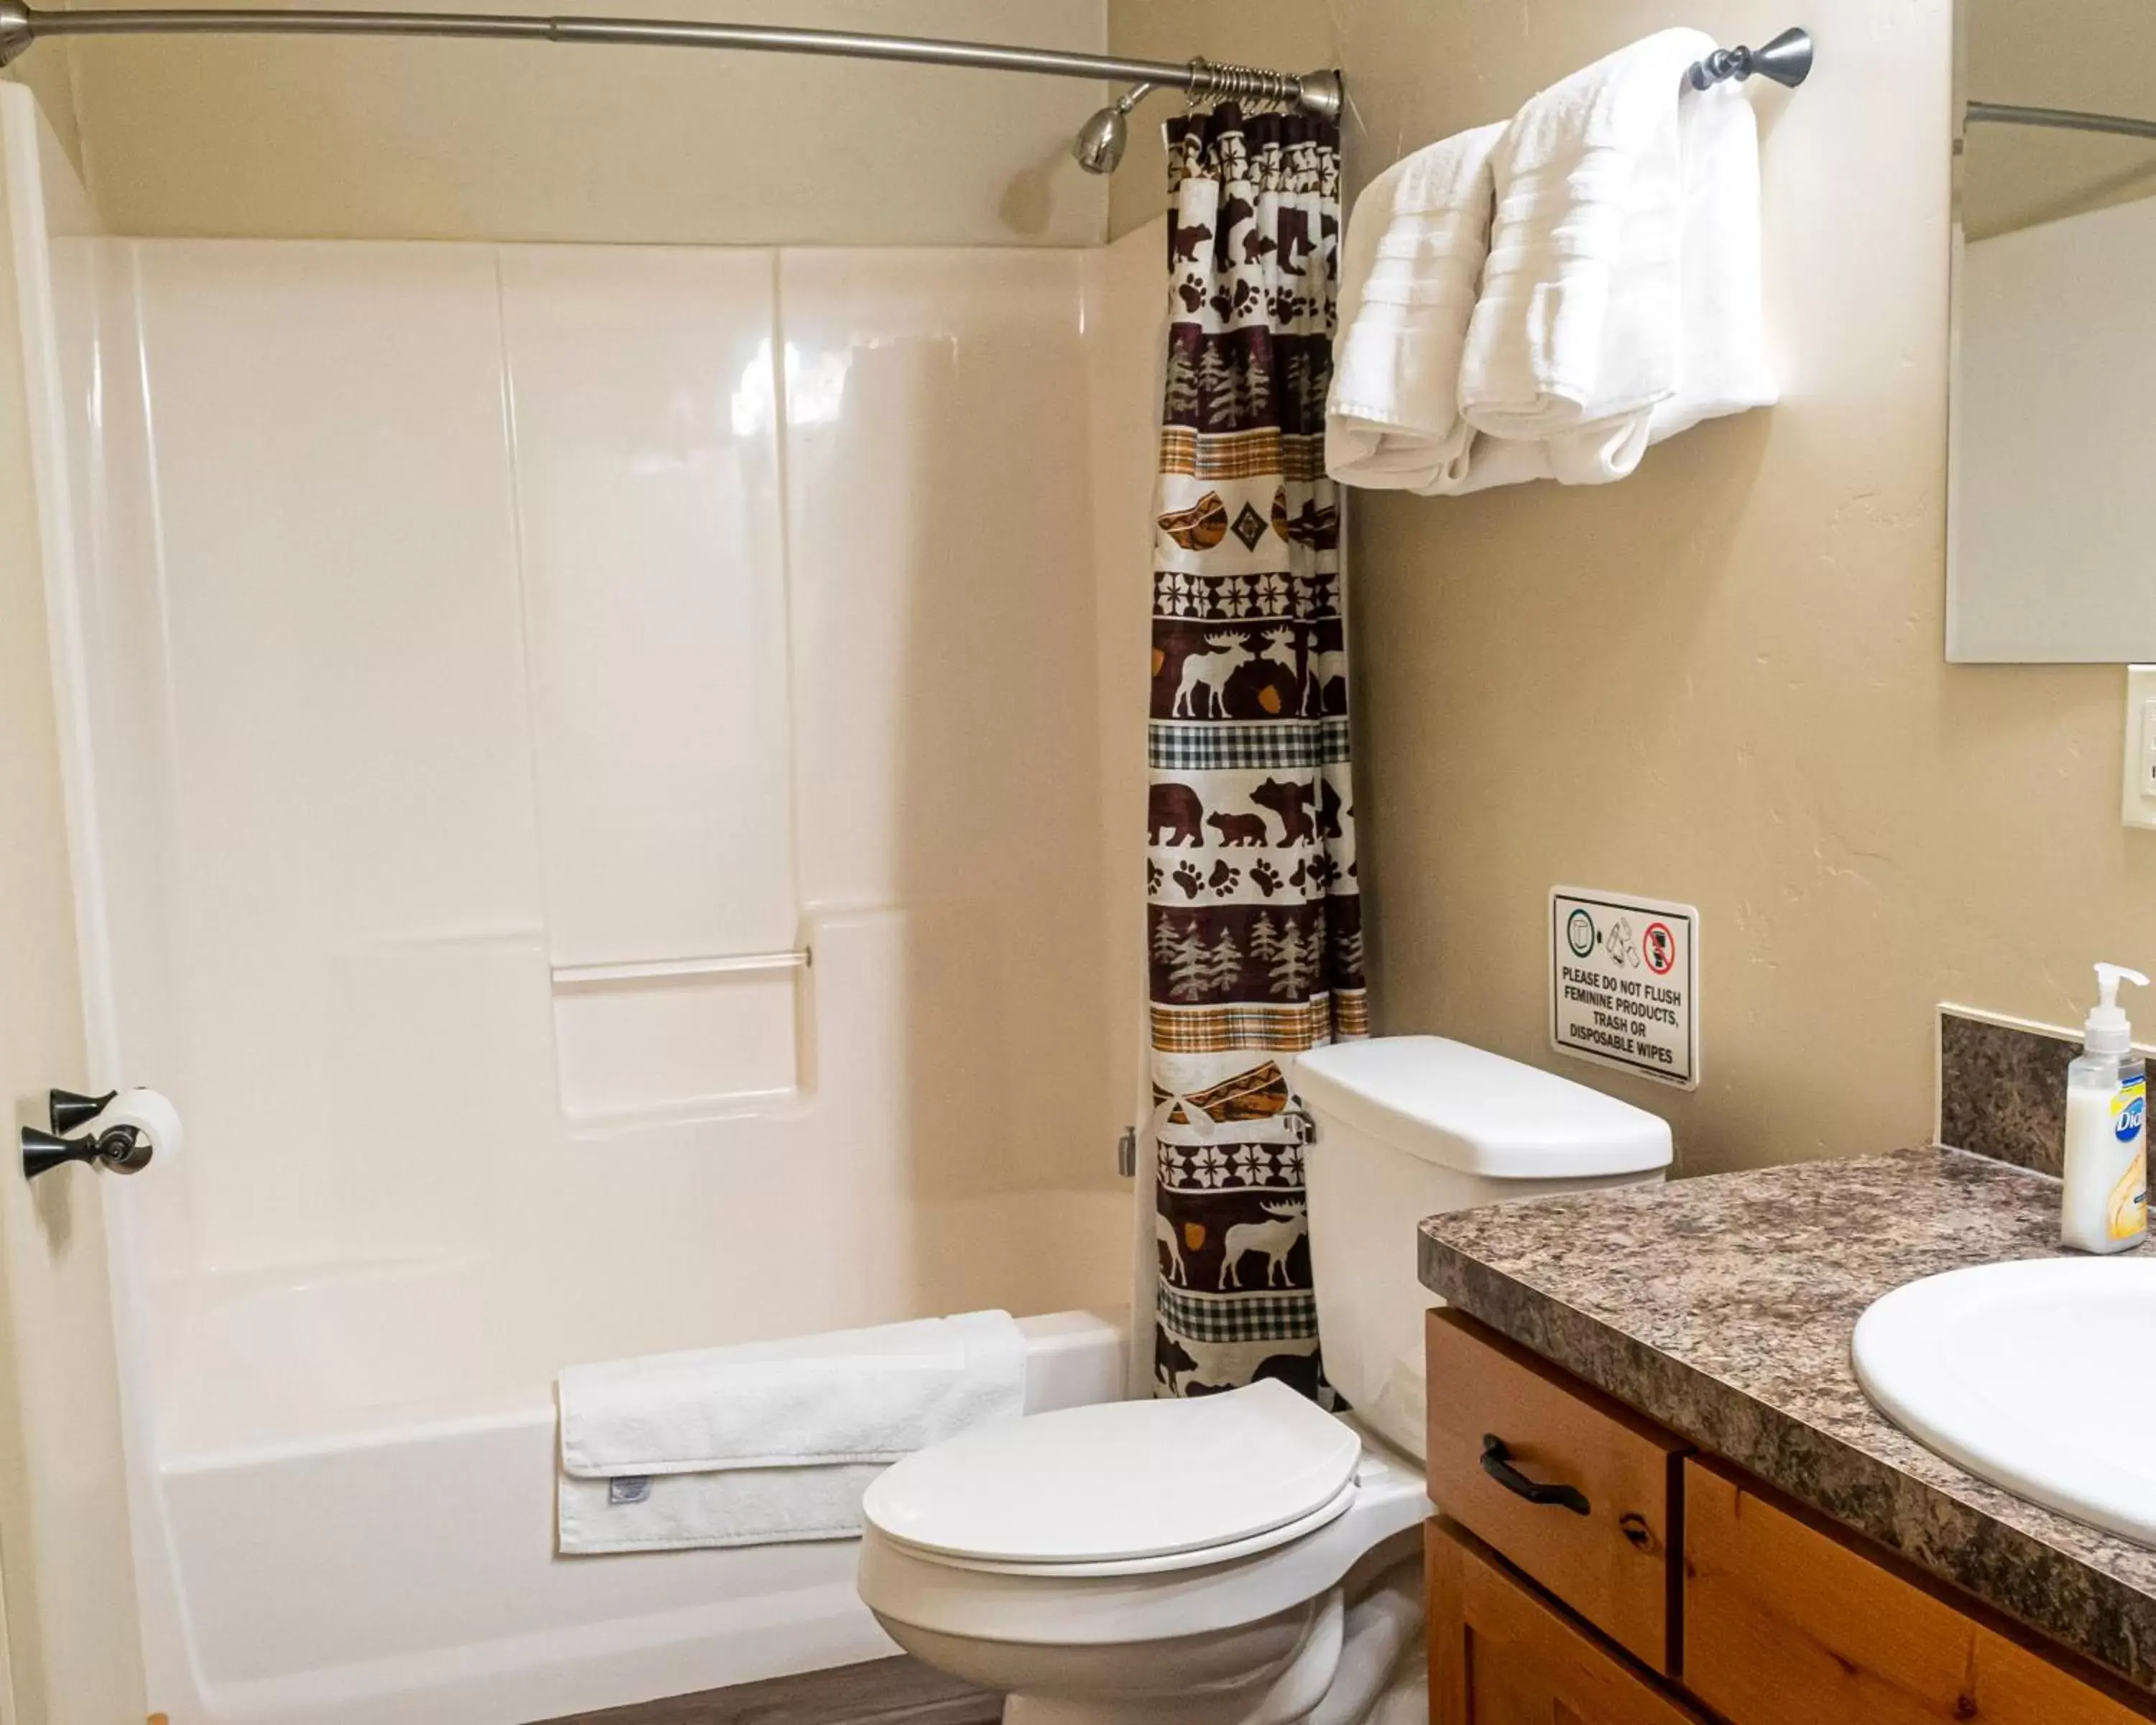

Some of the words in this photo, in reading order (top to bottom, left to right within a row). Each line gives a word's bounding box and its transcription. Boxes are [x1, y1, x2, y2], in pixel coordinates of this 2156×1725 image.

[1562, 966, 1600, 988] PLEASE
[1603, 975, 1617, 992] DO
[1621, 980, 1641, 998] NOT
[1644, 984, 1681, 1006] FLUSH
[1565, 985, 1613, 1009] FEMININE
[1616, 997, 1679, 1029] PRODUCTS,
[1593, 1011, 1628, 1033] TRASH
[1631, 1021, 1646, 1038] OR
[1570, 1023, 1634, 1054] DISPOSABLE
[1637, 1041, 1673, 1064] WIPES
